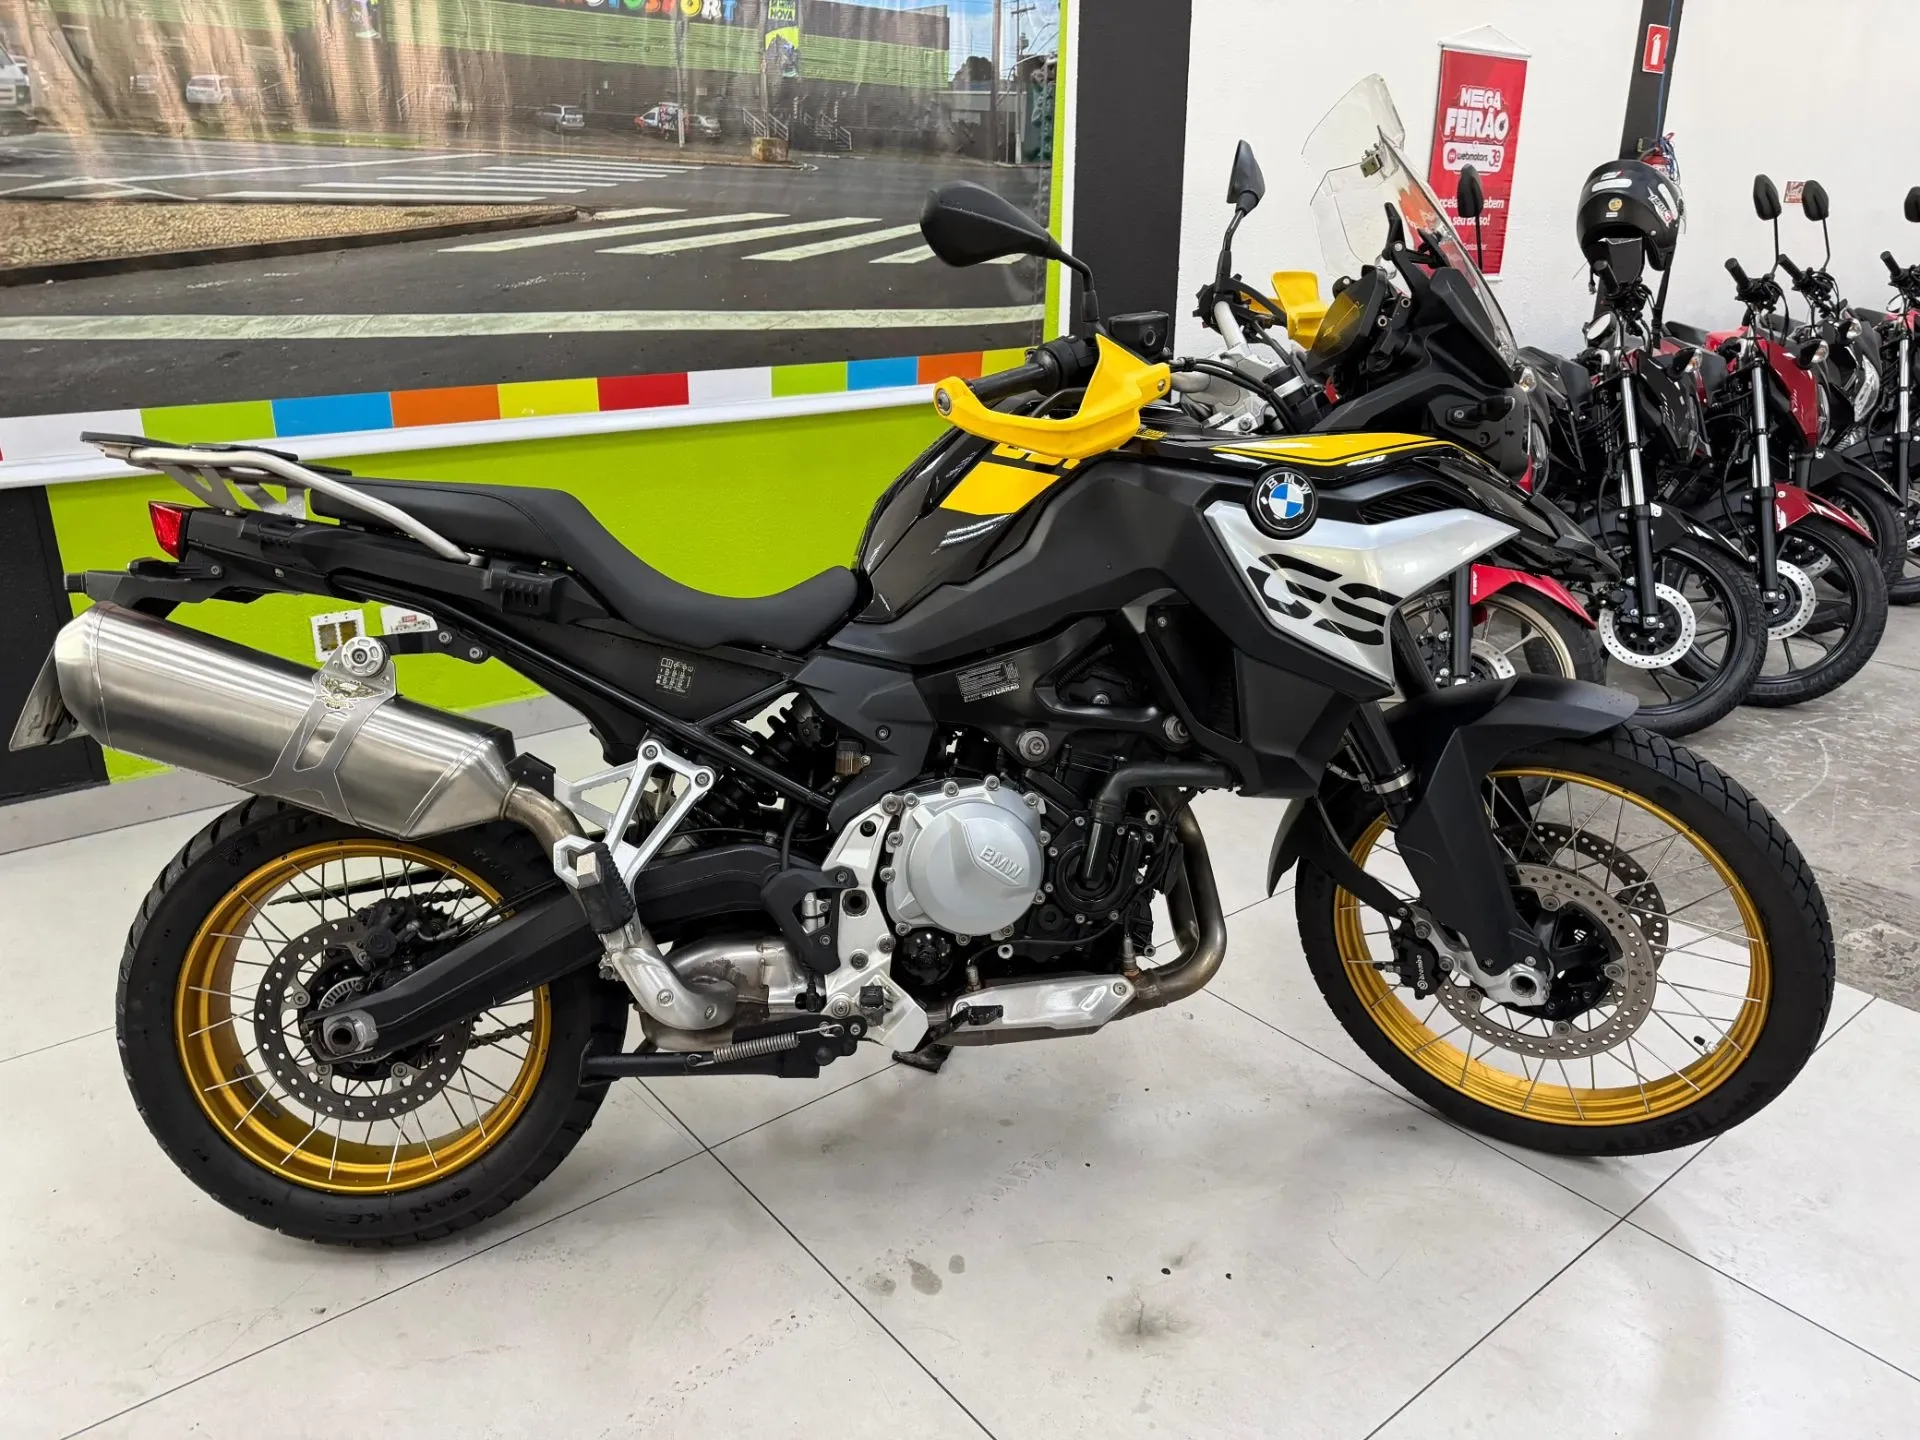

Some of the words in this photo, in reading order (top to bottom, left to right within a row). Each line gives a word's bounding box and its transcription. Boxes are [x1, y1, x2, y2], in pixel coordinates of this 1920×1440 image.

[1460, 87, 1502, 110] MEGA
[1443, 106, 1509, 141] FEIRÃO
[1457, 151, 1488, 162] webmotors
[1483, 195, 1504, 209] abem
[1266, 472, 1312, 495] BMW
[979, 845, 1024, 880] BMW
